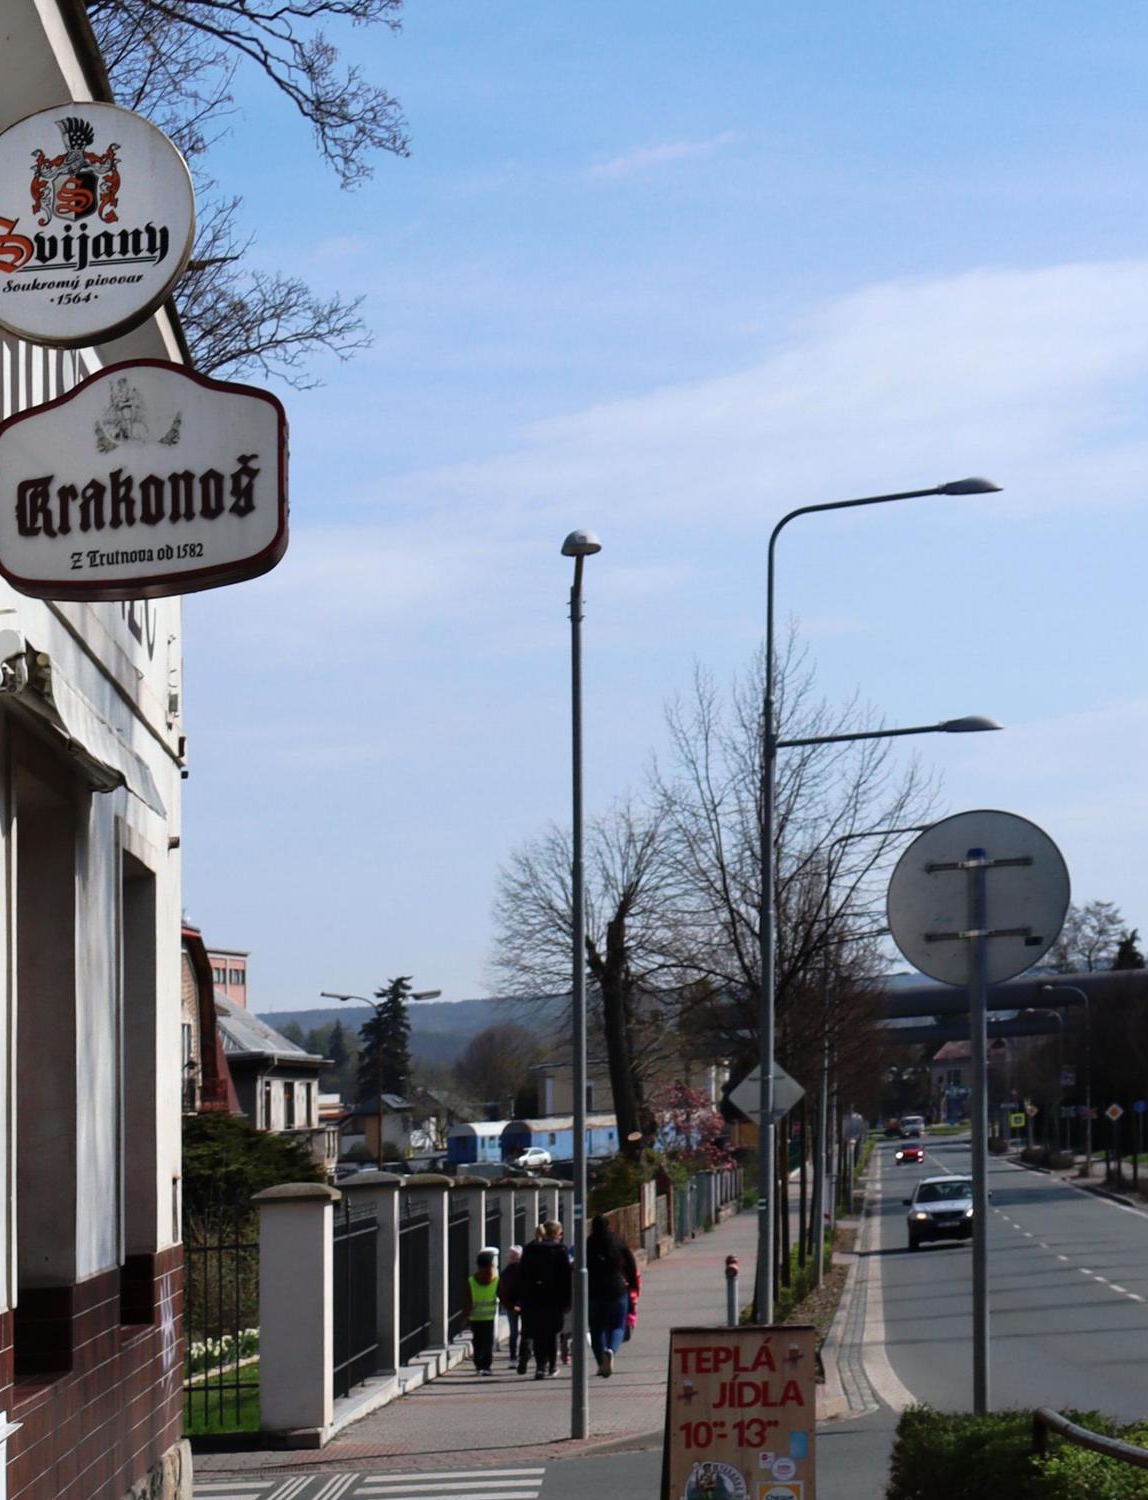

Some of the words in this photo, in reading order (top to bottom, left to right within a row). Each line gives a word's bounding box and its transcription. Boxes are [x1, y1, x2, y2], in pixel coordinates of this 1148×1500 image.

[2, 275, 80, 293] Soukromý
[85, 274, 144, 290] pivovar
[15, 453, 260, 538] Krakonoš
[70, 552, 83, 570] Z
[86, 549, 153, 568] Trutnova
[157, 544, 173, 561] od
[176, 542, 204, 559] 1582
[674, 1336, 776, 1374] TEPLÁ
[712, 1373, 804, 1409] JÍDLA
